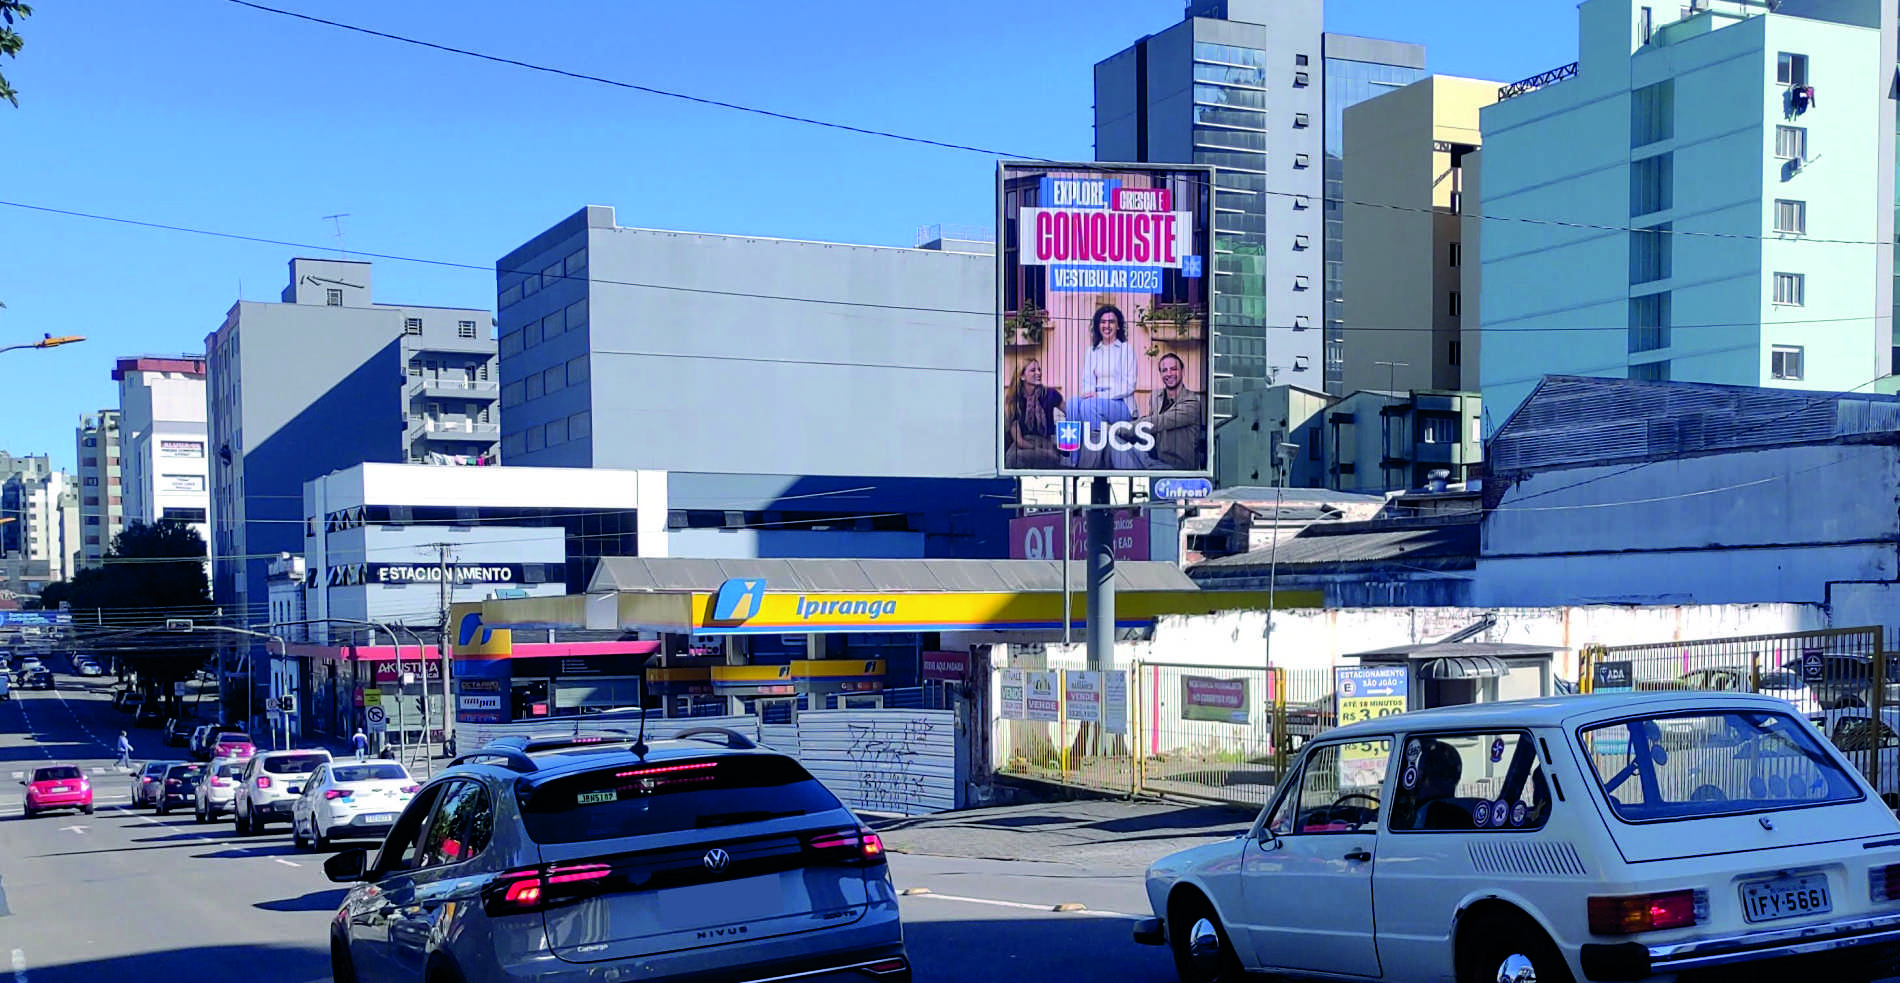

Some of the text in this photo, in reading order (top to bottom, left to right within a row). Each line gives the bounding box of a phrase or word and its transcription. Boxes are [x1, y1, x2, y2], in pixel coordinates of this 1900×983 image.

[1054, 180, 1107, 209] EXPLORE,
[1158, 191, 1164, 211] E
[1037, 211, 1176, 262] CONQUISTE
[1055, 268, 1158, 288] VESTIBULAR 2025
[1083, 421, 1156, 452] UCS
[1024, 525, 1054, 560] QI
[1118, 537, 1133, 549] EAD
[379, 566, 512, 581] ESTACIONAMENTO
[796, 596, 897, 619] Ipiranga
[1340, 670, 1405, 679] ESTACIONAMENTO
[1344, 683, 1353, 692] E
[1363, 678, 1398, 688] SÃO JOÃO
[1070, 692, 1095, 701] VENDE
[1369, 699, 1403, 707] MINUTOS
[1028, 701, 1057, 710] VENDE
[697, 926, 748, 940] NIVUS
